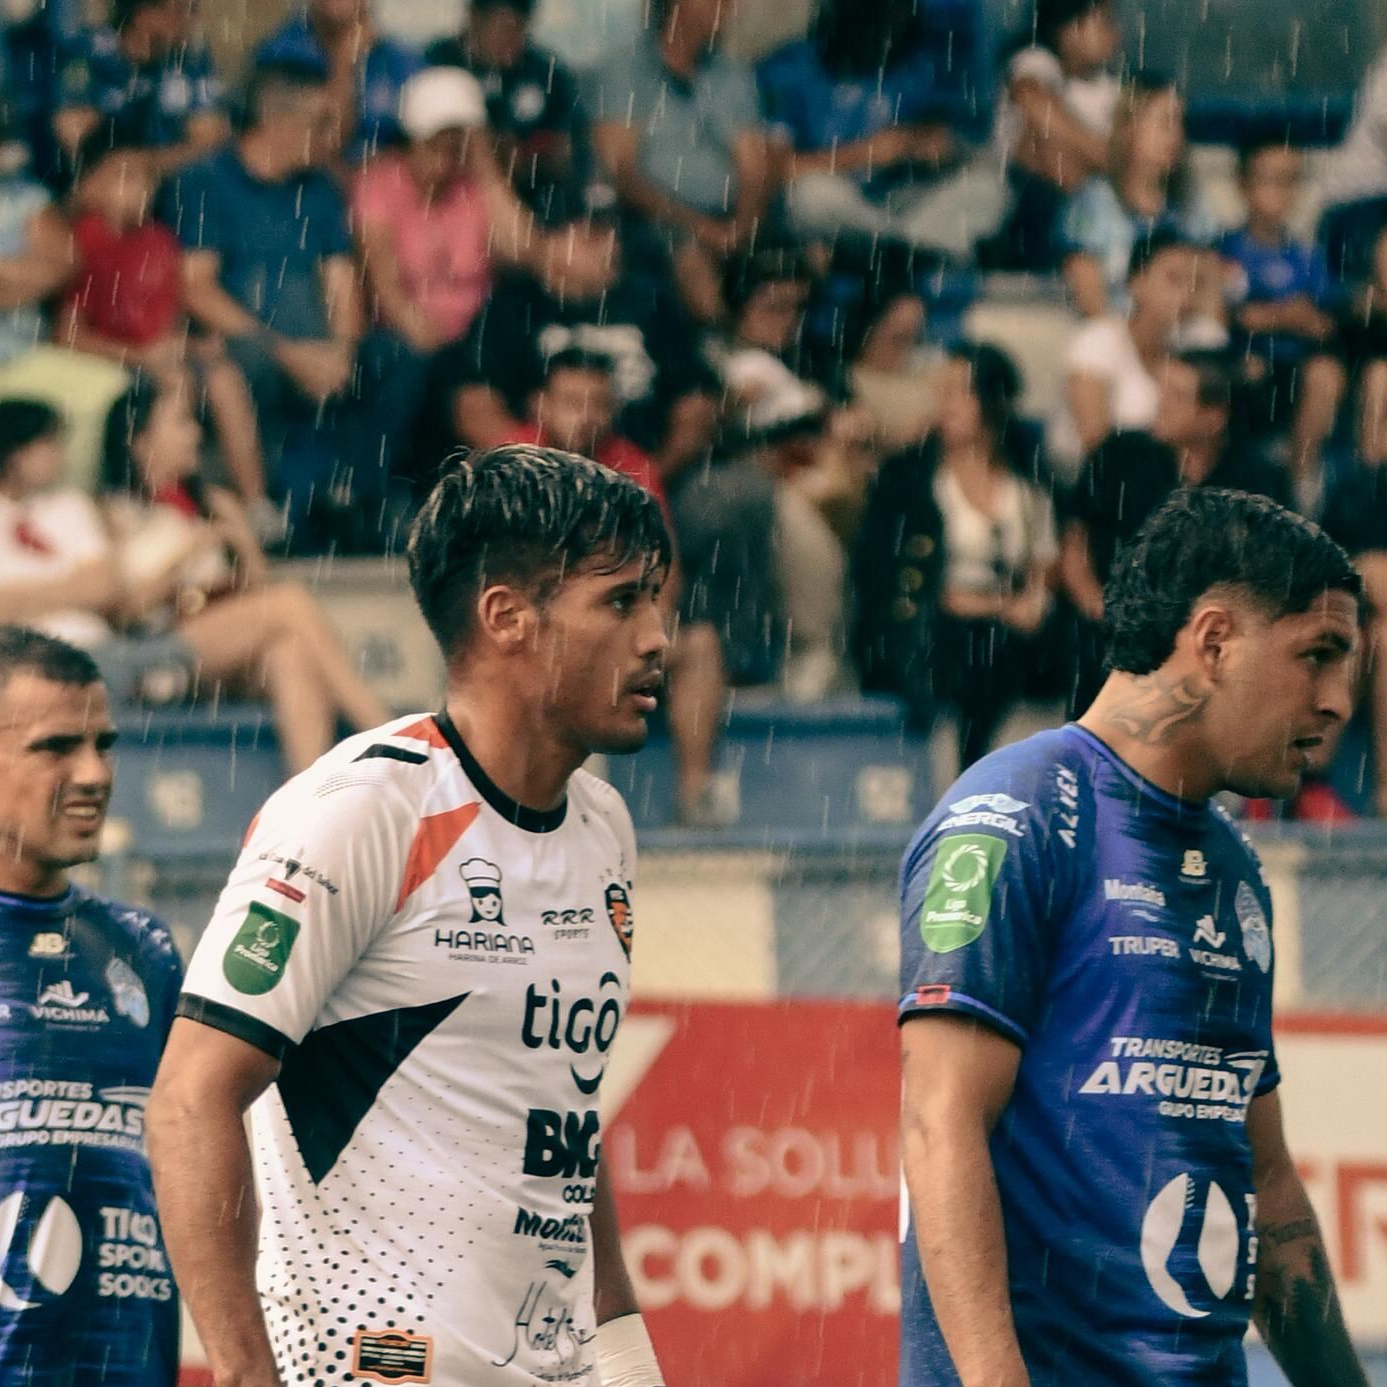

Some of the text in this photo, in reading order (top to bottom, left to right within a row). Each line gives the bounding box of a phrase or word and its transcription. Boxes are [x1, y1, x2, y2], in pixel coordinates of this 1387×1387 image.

[540, 908, 595, 926] RRR
[434, 929, 536, 955] HARIANA
[1108, 936, 1181, 959] TRUPER
[29, 1005, 110, 1025] VICHIMA
[520, 978, 621, 1054] tigo
[1110, 1036, 1223, 1067] TRANSPORTES
[612, 1123, 901, 1199] LA SOLU
[626, 1223, 901, 1317] COMPL
